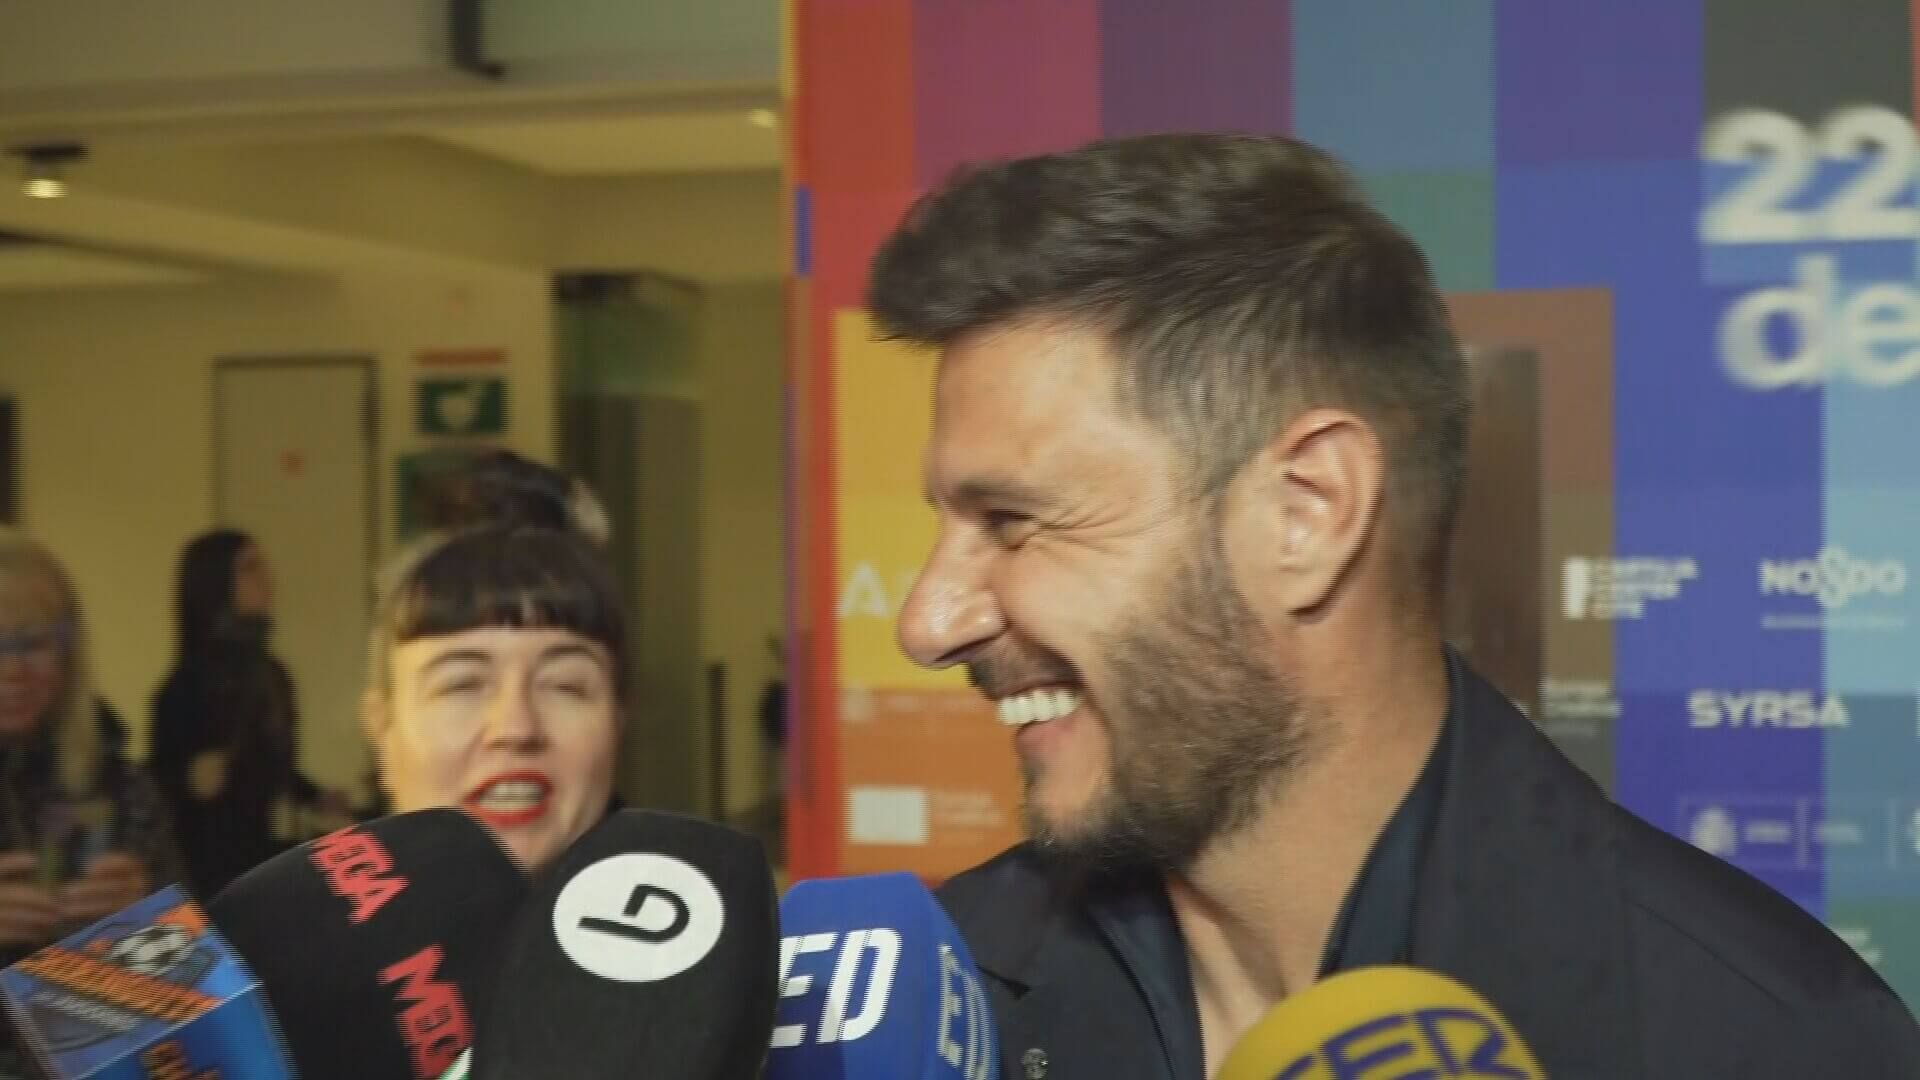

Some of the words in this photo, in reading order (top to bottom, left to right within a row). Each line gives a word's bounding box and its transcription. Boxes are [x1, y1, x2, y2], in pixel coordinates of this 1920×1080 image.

[1699, 106, 1920, 243] 22
[1717, 252, 1920, 388] de
[1688, 688, 1850, 729] SYRSA
[378, 944, 474, 1080] MEG
[770, 928, 902, 1048] ED
[1275, 1009, 1532, 1080] ER
